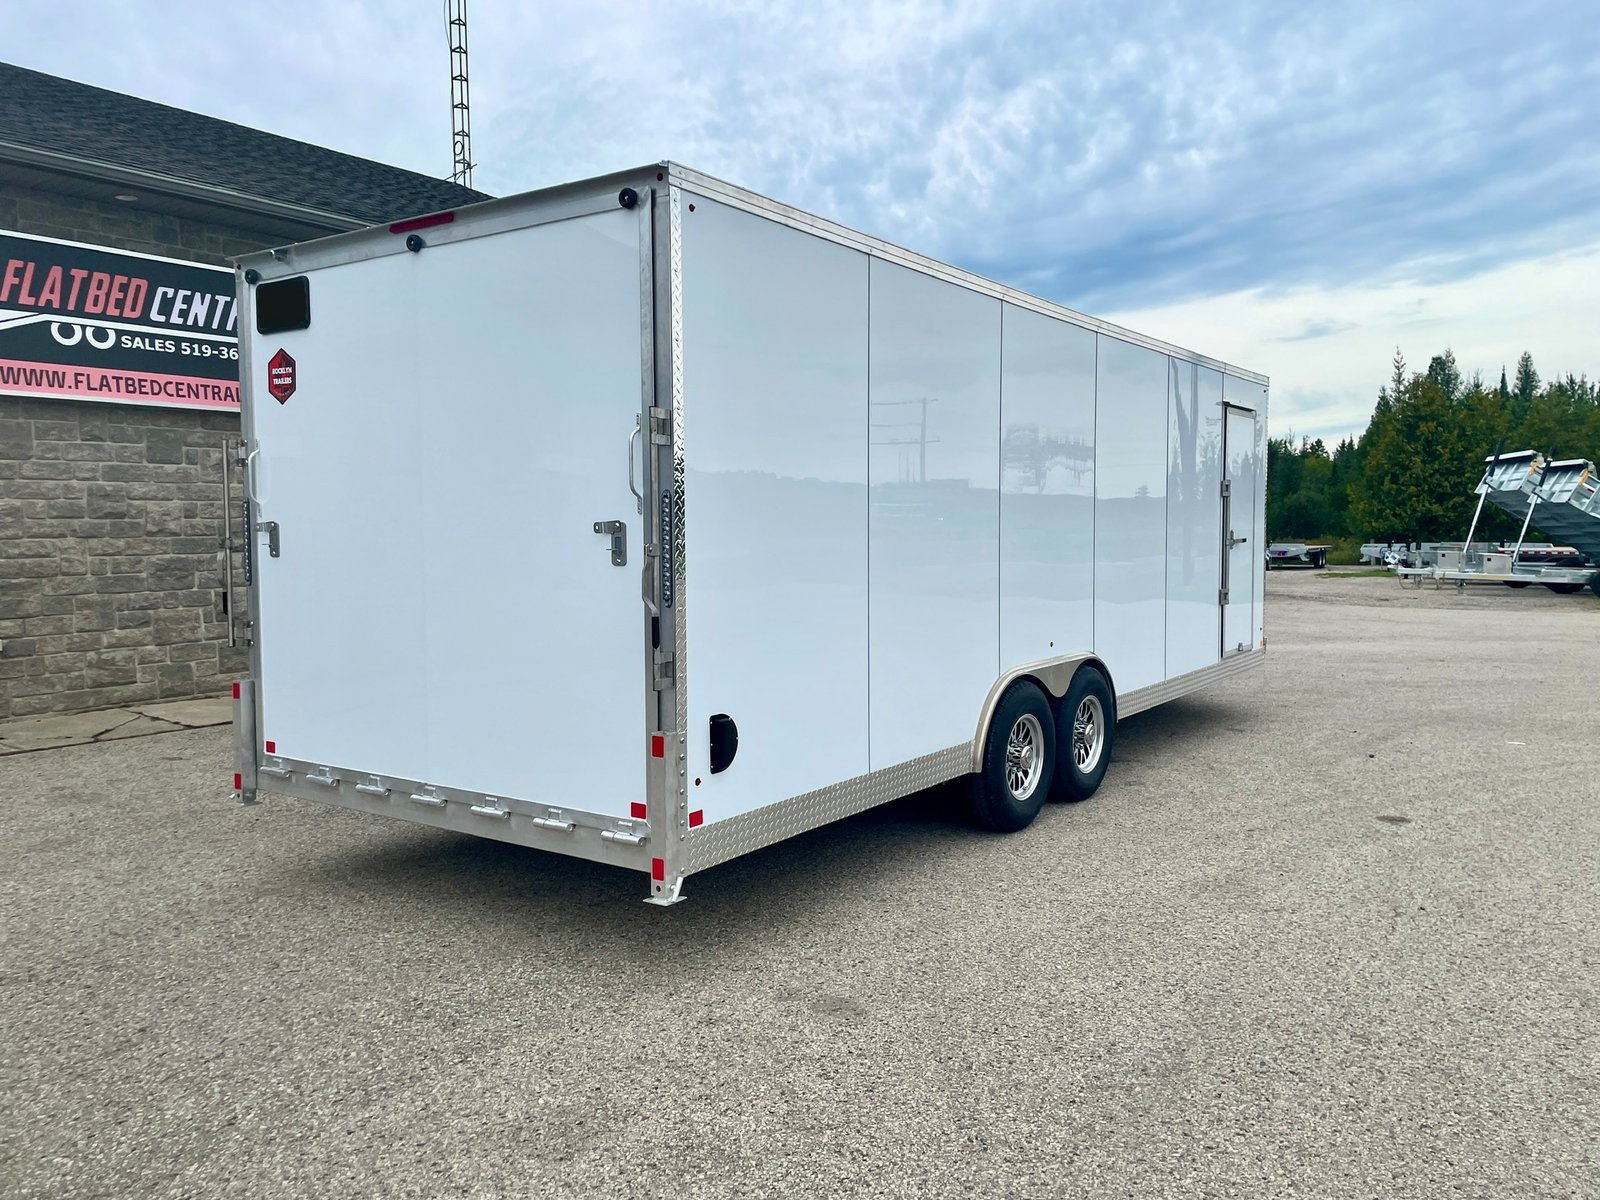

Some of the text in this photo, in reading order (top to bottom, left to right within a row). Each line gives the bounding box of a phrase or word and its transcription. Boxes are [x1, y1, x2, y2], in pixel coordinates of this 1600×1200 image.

[0, 258, 149, 319] FLATBED
[120, 335, 239, 360] SALES 519-36
